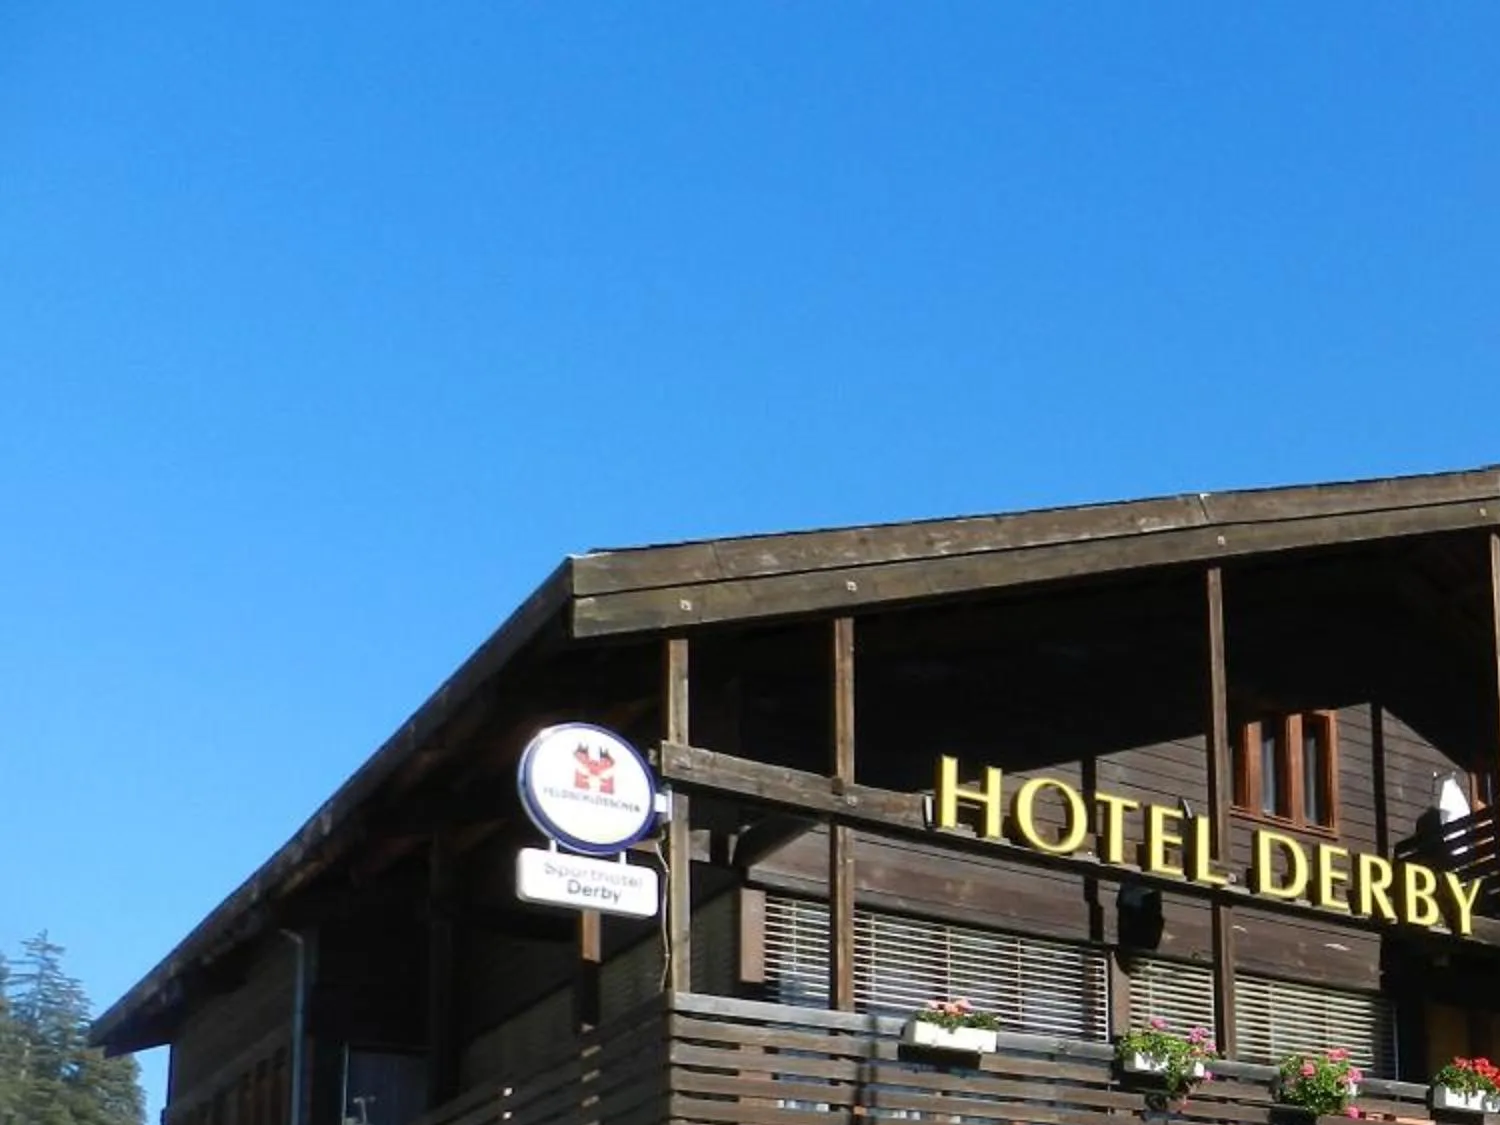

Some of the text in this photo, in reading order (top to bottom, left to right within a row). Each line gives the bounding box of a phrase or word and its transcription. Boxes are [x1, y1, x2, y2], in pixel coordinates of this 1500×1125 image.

[567, 879, 622, 904] Derby
[935, 755, 1483, 935] HOTEL DERBY
